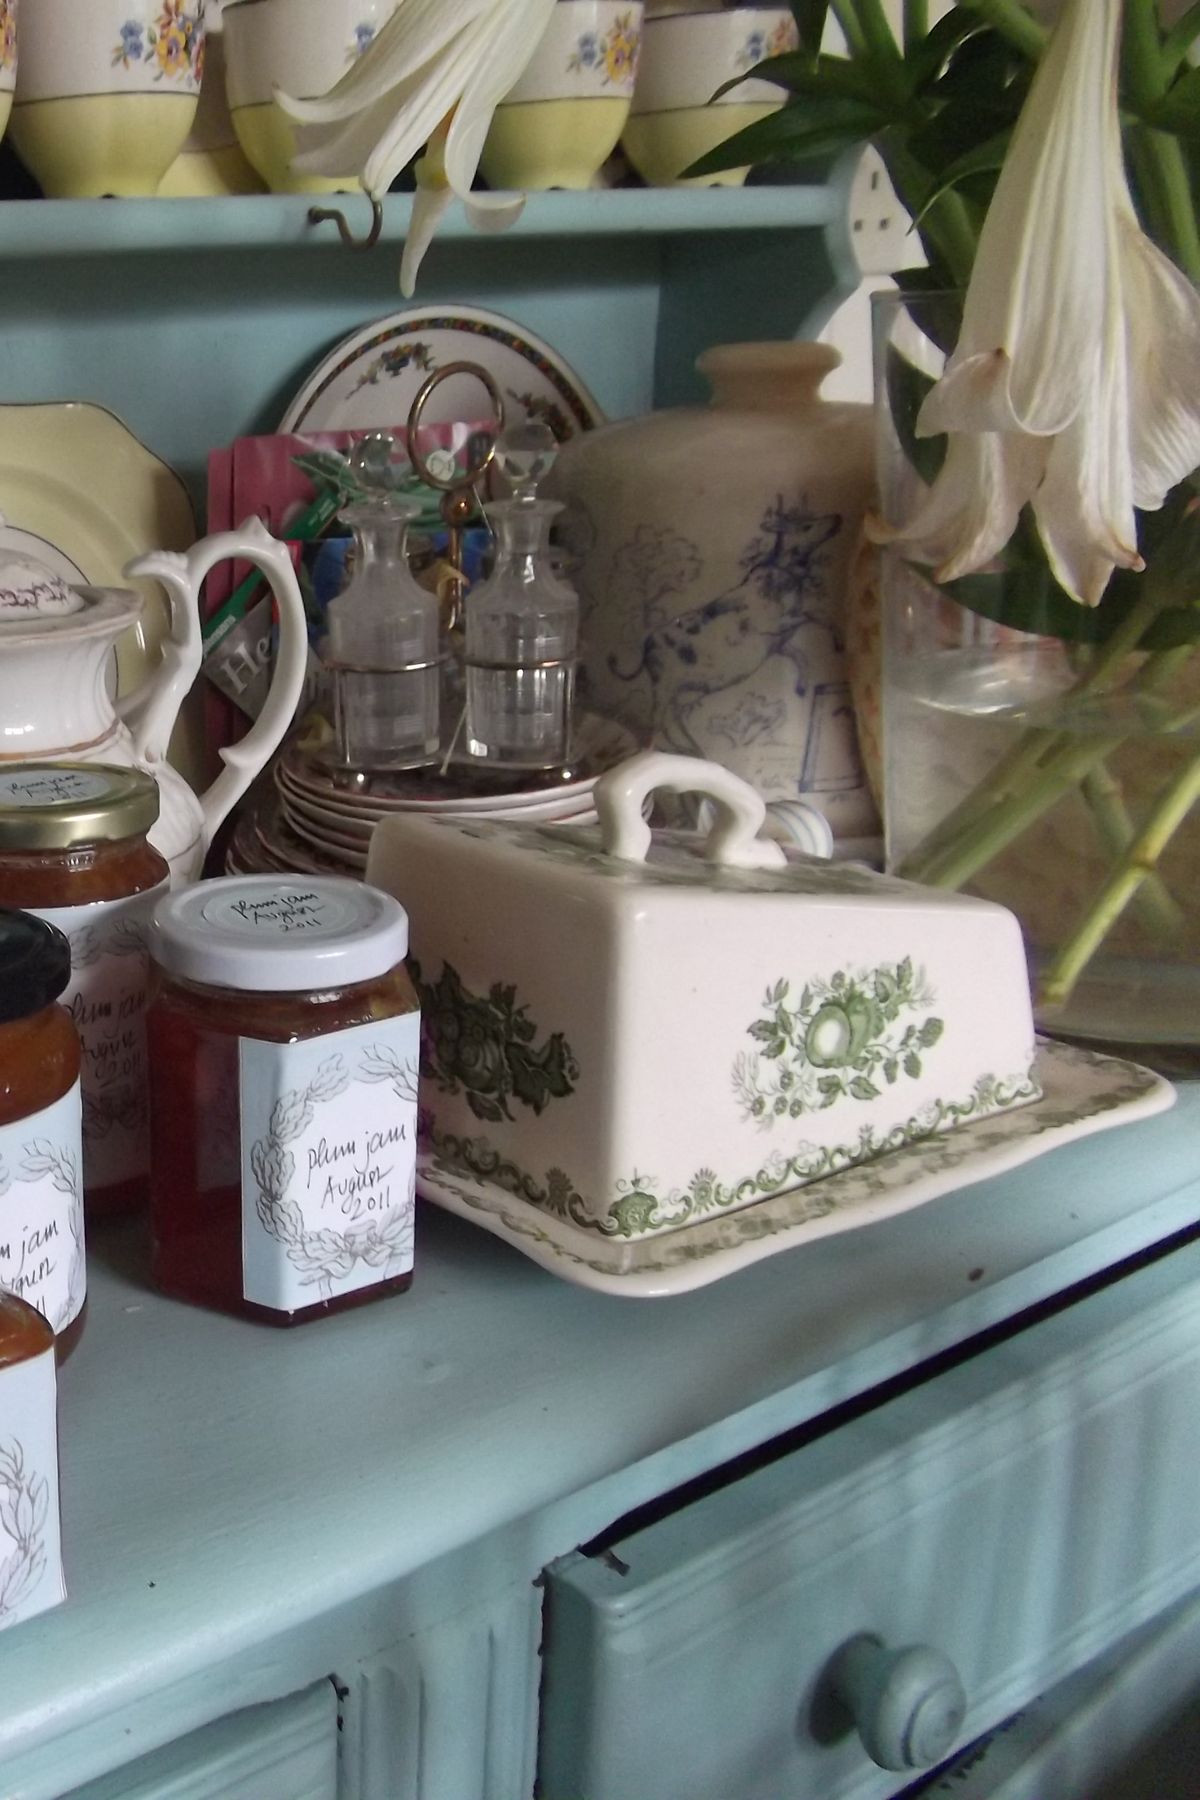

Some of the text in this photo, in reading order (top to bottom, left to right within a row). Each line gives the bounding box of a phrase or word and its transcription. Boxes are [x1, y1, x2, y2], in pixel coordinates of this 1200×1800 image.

[230, 893, 319, 920] plum jam
[253, 904, 325, 924] August
[279, 918, 322, 932] 2011
[306, 1123, 407, 1190] plum jam
[320, 1164, 394, 1215] August
[349, 1185, 391, 1222] 2011
[13, 1219, 59, 1280] jam
